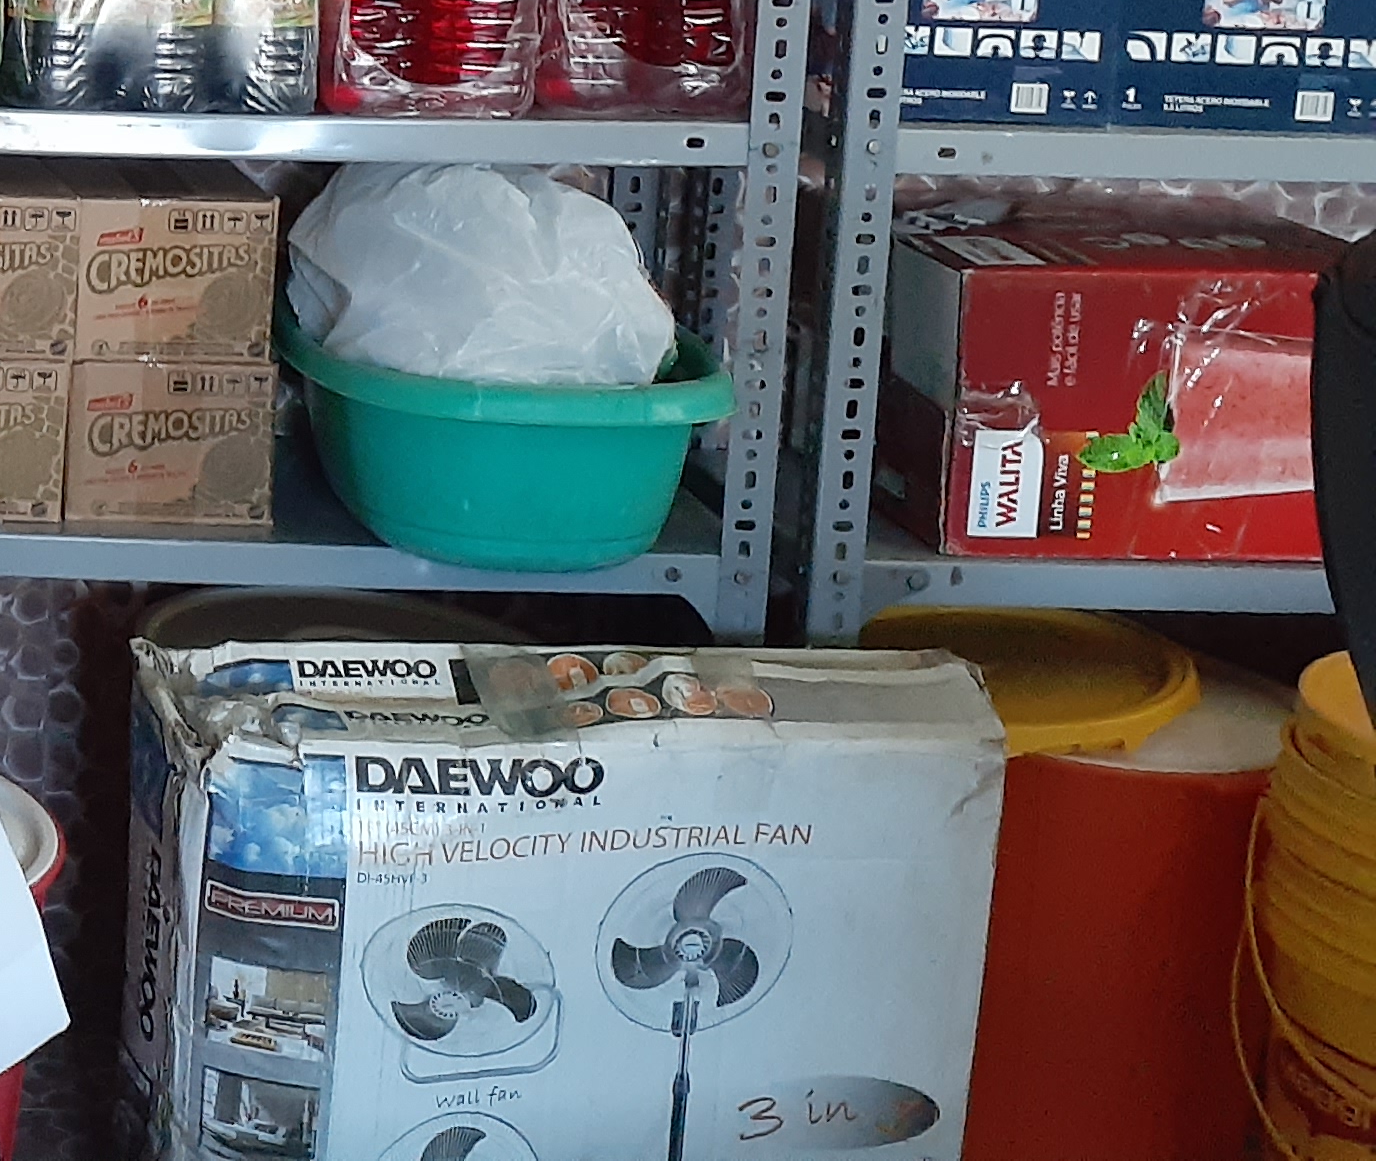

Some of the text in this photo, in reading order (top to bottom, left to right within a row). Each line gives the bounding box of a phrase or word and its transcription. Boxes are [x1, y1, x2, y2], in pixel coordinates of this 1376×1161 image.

[86, 244, 251, 294] CREMOSITAS
[88, 407, 251, 457] CREMOSITAS
[977, 481, 991, 528] PHILIPS
[995, 439, 1024, 527] WALITA
[1049, 454, 1070, 531] Linha Viva
[298, 659, 437, 678] DAEWOO
[299, 678, 441, 687] INTERNATIONAL
[344, 710, 491, 727] DAEWOO
[355, 755, 605, 798] DAEWOO
[356, 796, 601, 814] INTERNATIONAL
[358, 823, 812, 866] HIGH VELOCITY INDUSTRIAL FAN
[211, 891, 333, 924] PREMIUM
[436, 1086, 523, 1108] wall fan
[737, 1089, 857, 1141] 3 in
